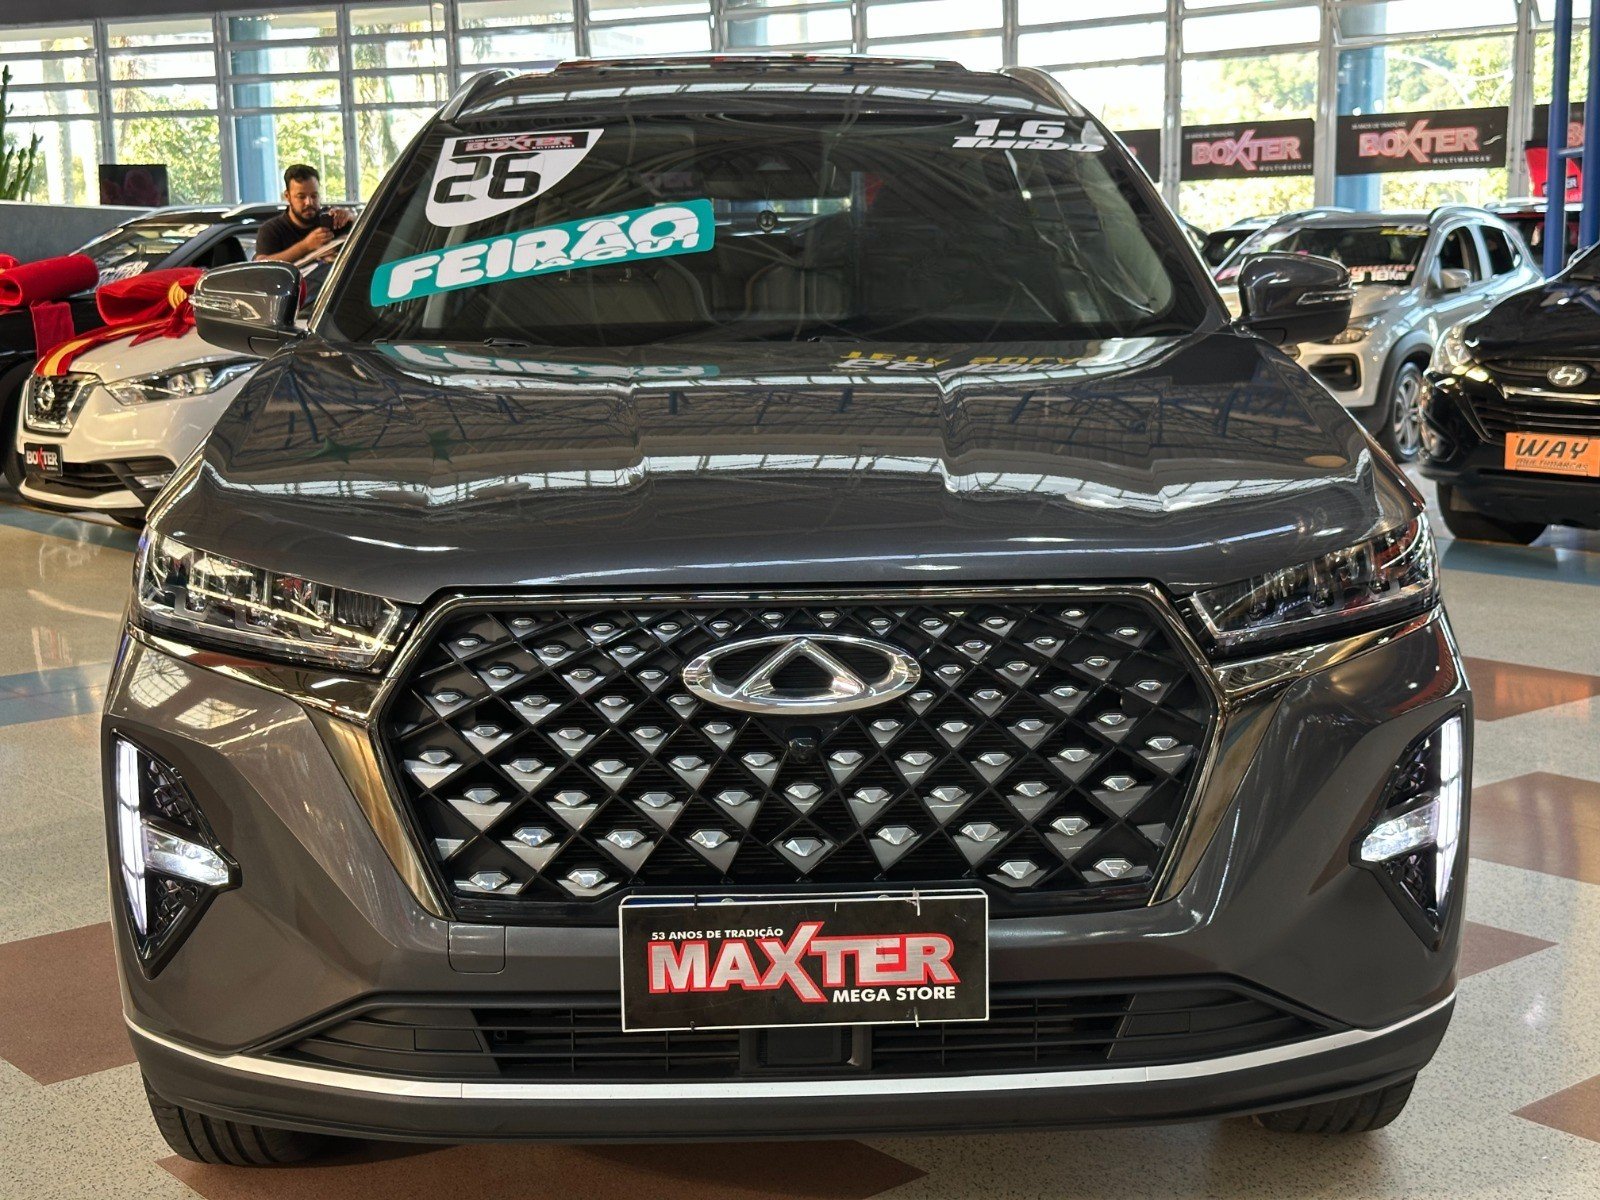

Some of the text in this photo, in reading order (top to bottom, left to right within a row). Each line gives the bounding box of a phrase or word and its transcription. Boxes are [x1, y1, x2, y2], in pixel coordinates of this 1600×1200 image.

[974, 118, 1066, 139] 1.6
[465, 135, 573, 151] BOXTER
[1191, 128, 1302, 171] BOXTER
[1359, 119, 1480, 163] BOXTER
[433, 151, 542, 203] 26
[387, 206, 699, 299] FEIRÃO
[26, 446, 58, 470] BOXTER
[1515, 438, 1589, 460] WAY
[651, 926, 784, 941] 53 ANOS DE TRADIÇÃO
[647, 921, 961, 1003] MAXTER
[832, 986, 956, 1003] MEGA STORE
